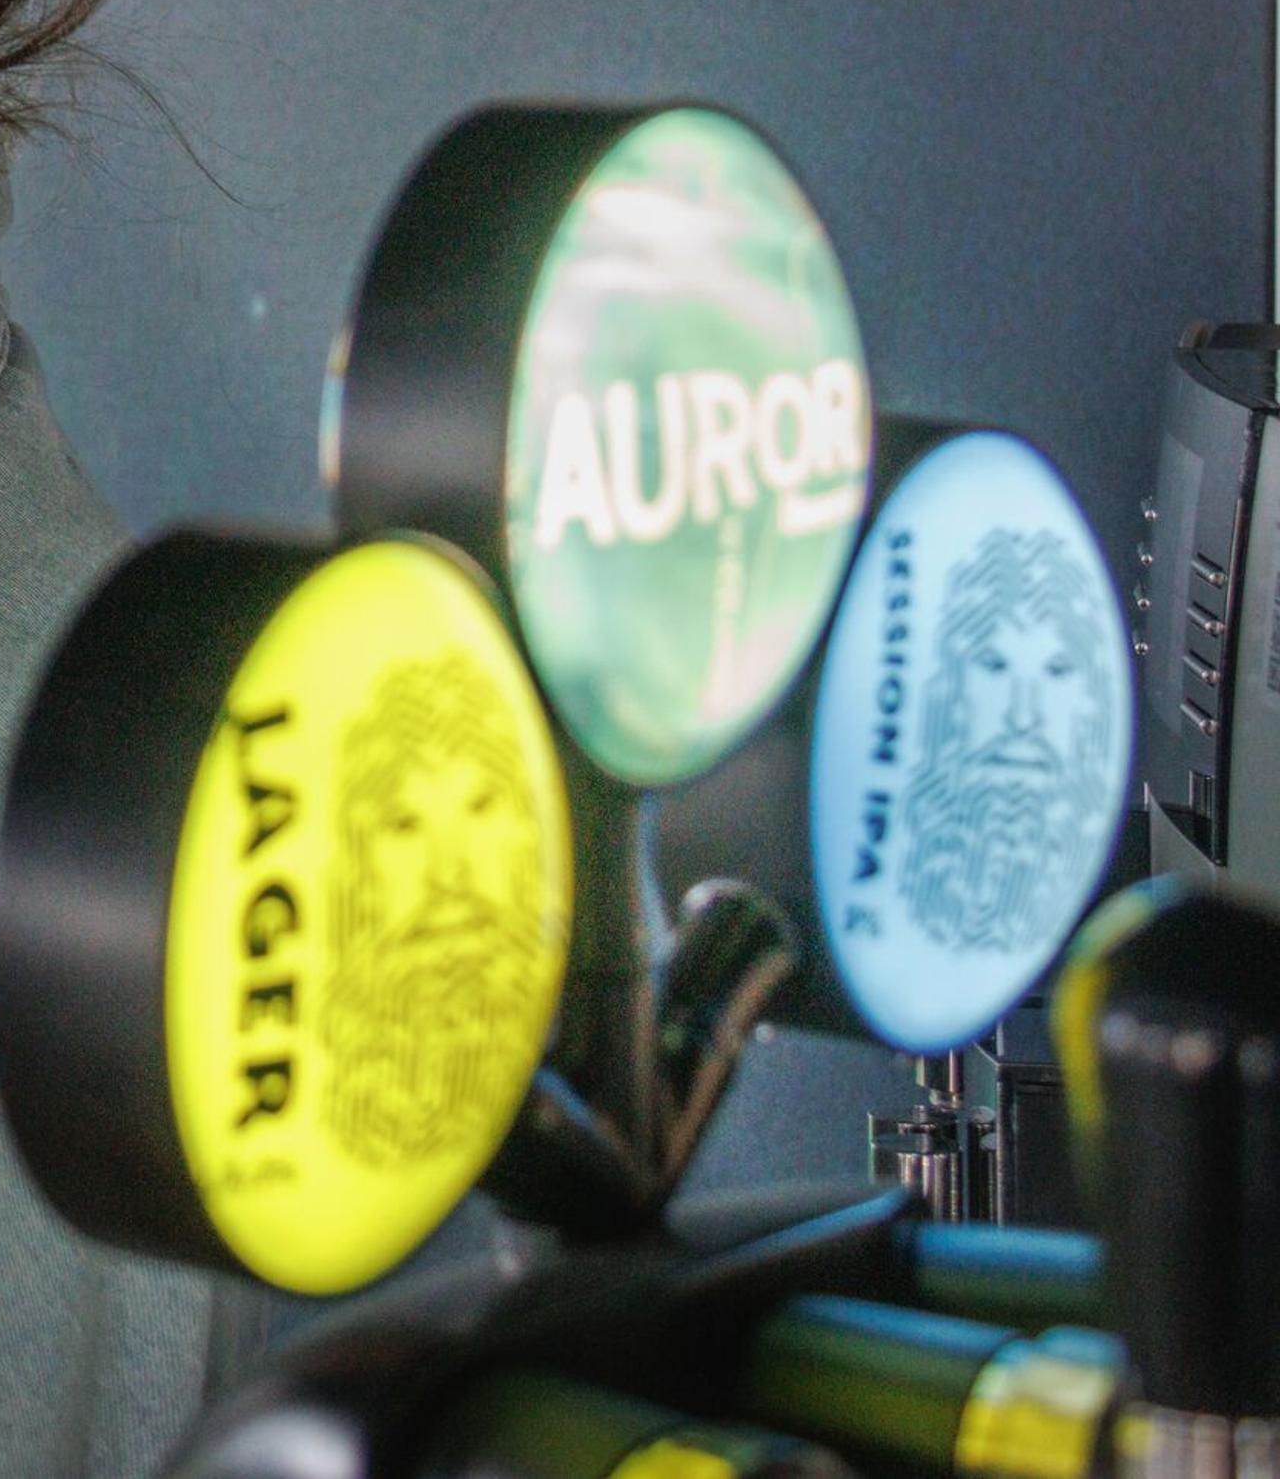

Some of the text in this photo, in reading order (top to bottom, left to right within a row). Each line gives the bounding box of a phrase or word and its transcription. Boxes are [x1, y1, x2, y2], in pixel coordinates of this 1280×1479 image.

[869, 528, 914, 766] SESSION
[233, 702, 302, 1133] LAGER
[851, 789, 892, 885] IPA
